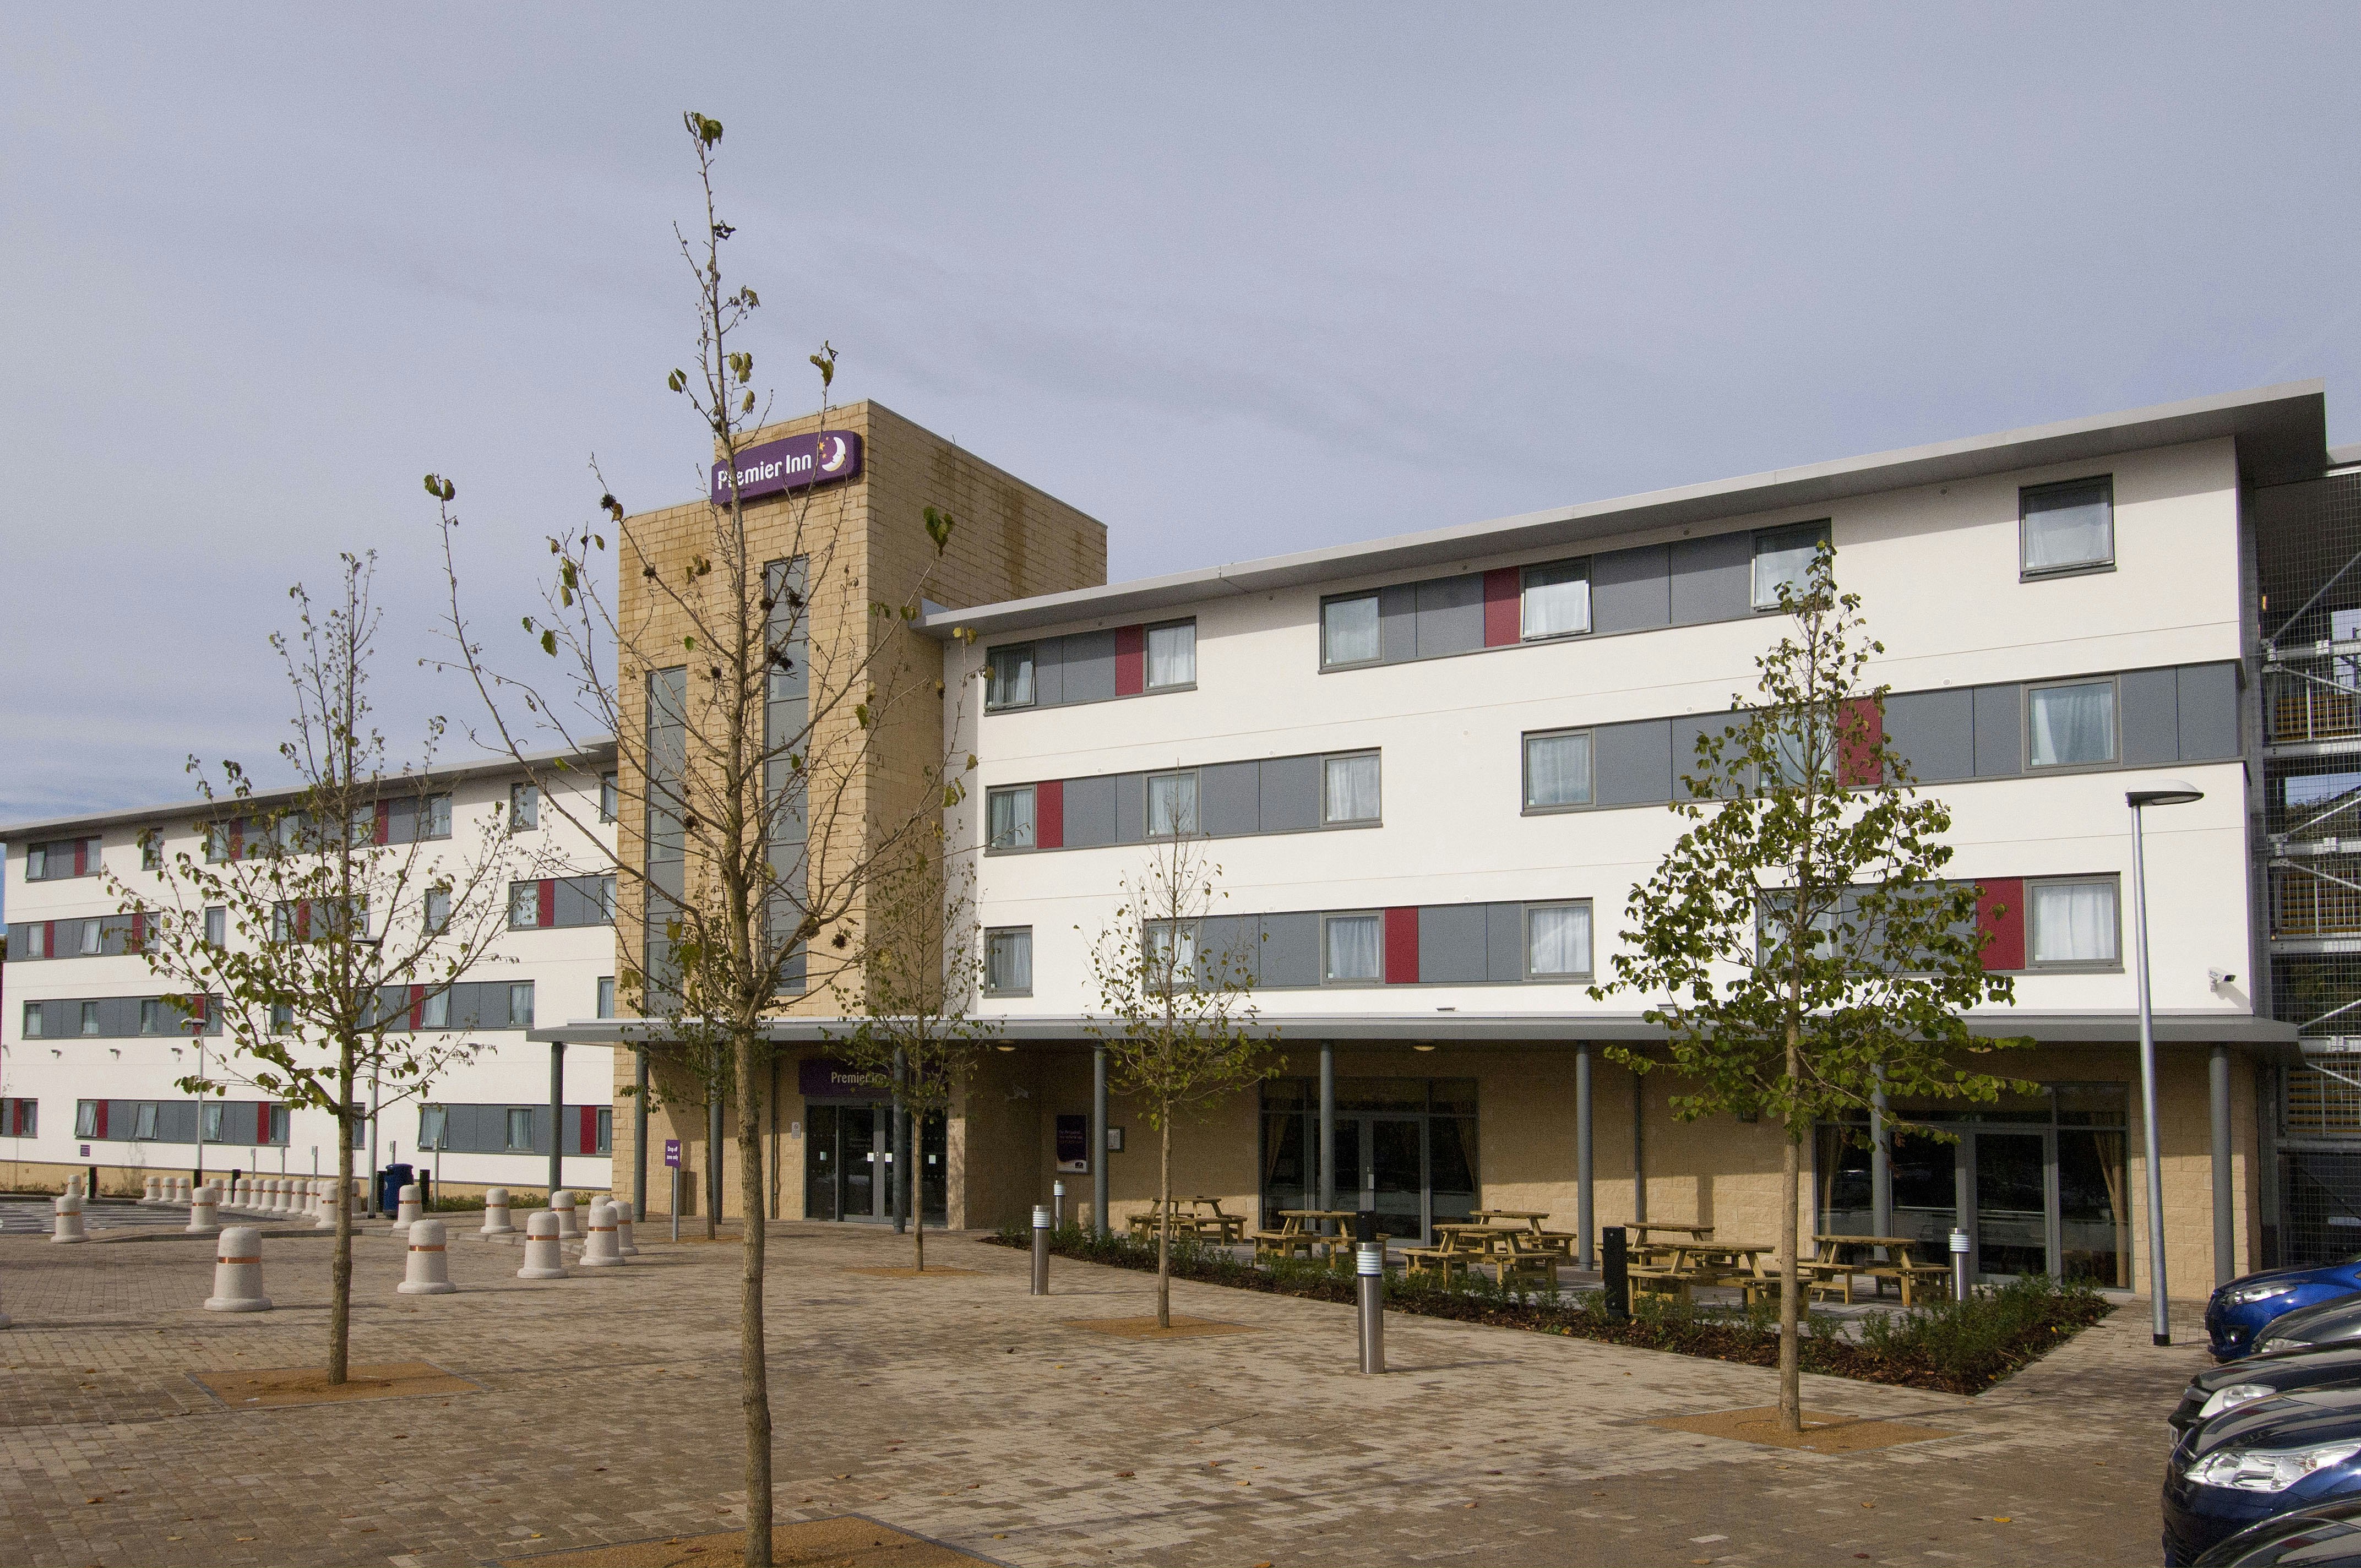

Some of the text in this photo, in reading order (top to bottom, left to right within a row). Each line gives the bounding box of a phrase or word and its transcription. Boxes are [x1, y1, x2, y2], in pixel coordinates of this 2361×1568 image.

[718, 454, 812, 490] Premier Inn
[831, 1071, 868, 1084] Premier
